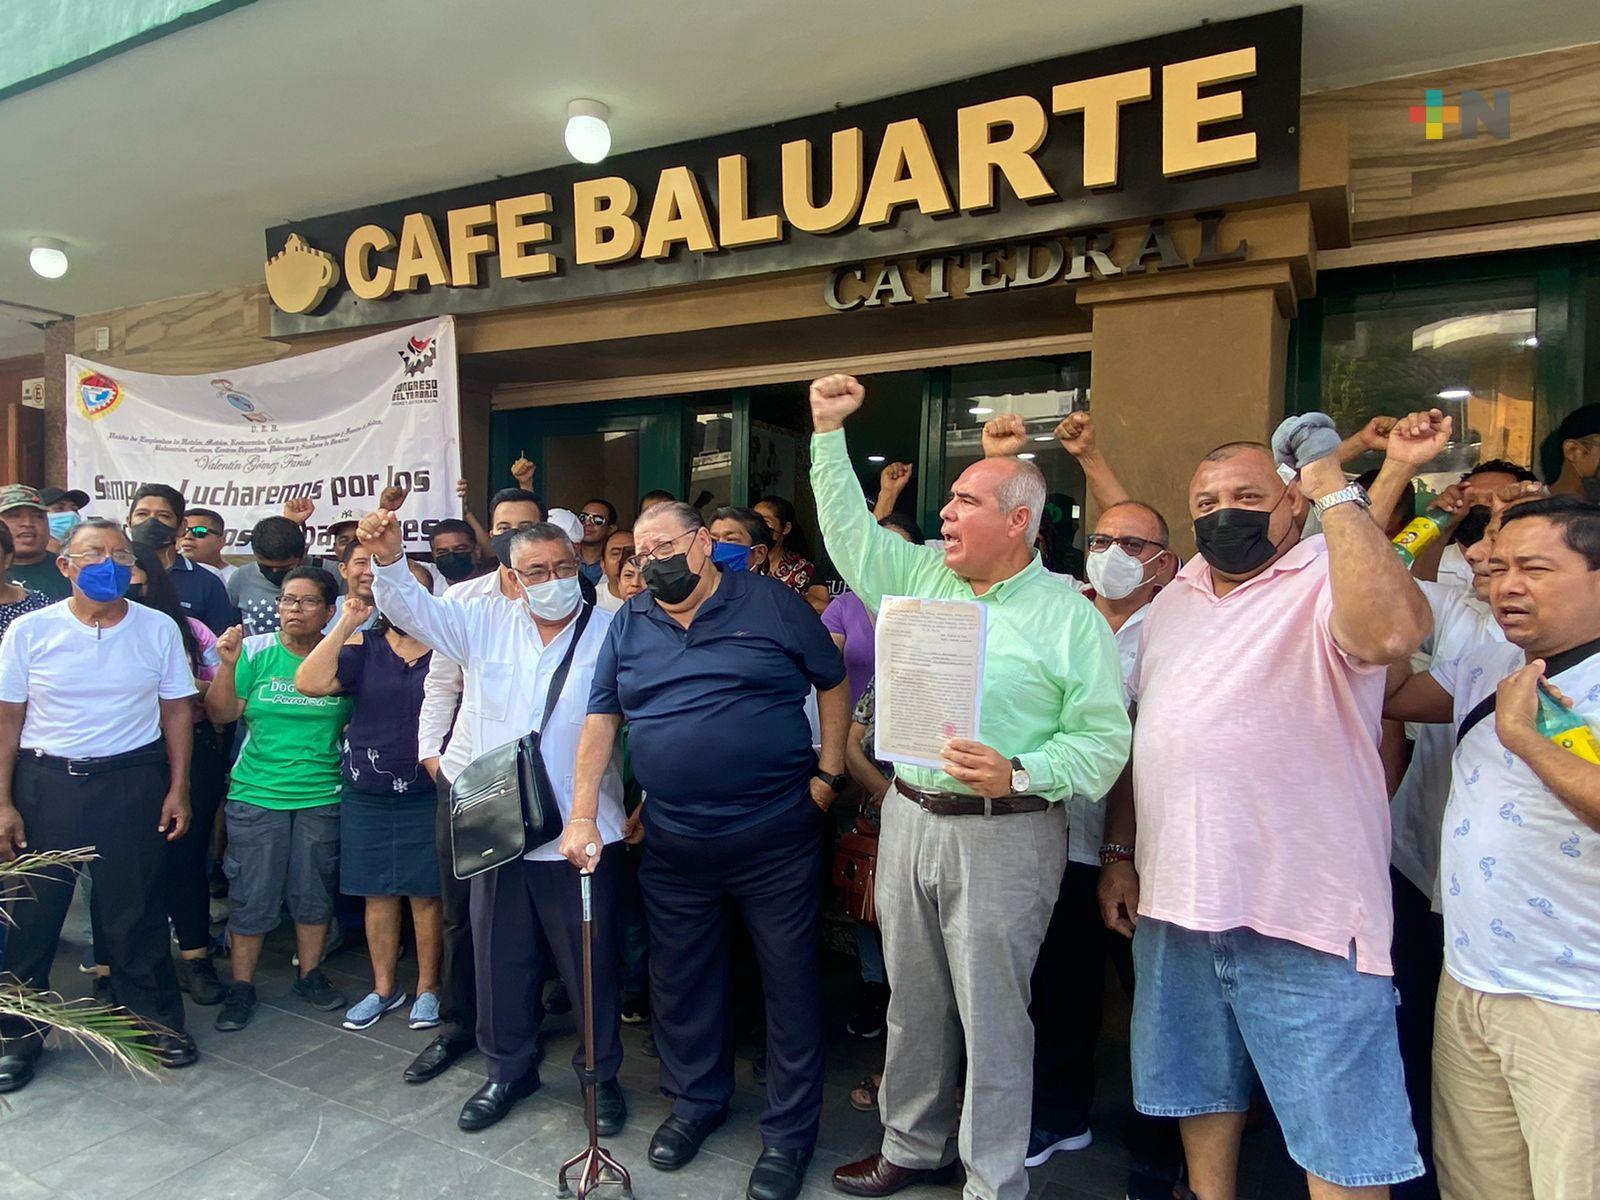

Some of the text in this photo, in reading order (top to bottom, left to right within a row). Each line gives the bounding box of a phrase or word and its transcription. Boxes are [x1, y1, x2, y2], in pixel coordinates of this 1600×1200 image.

[344, 46, 1257, 299] CAFE BALUARTE
[823, 210, 1249, 312] CATEDRAL
[394, 379, 438, 393] CONGRESO
[406, 390, 439, 400] TRABAJO
[180, 478, 324, 507] Lucharemos
[331, 473, 379, 506] por
[387, 465, 430, 493] los
